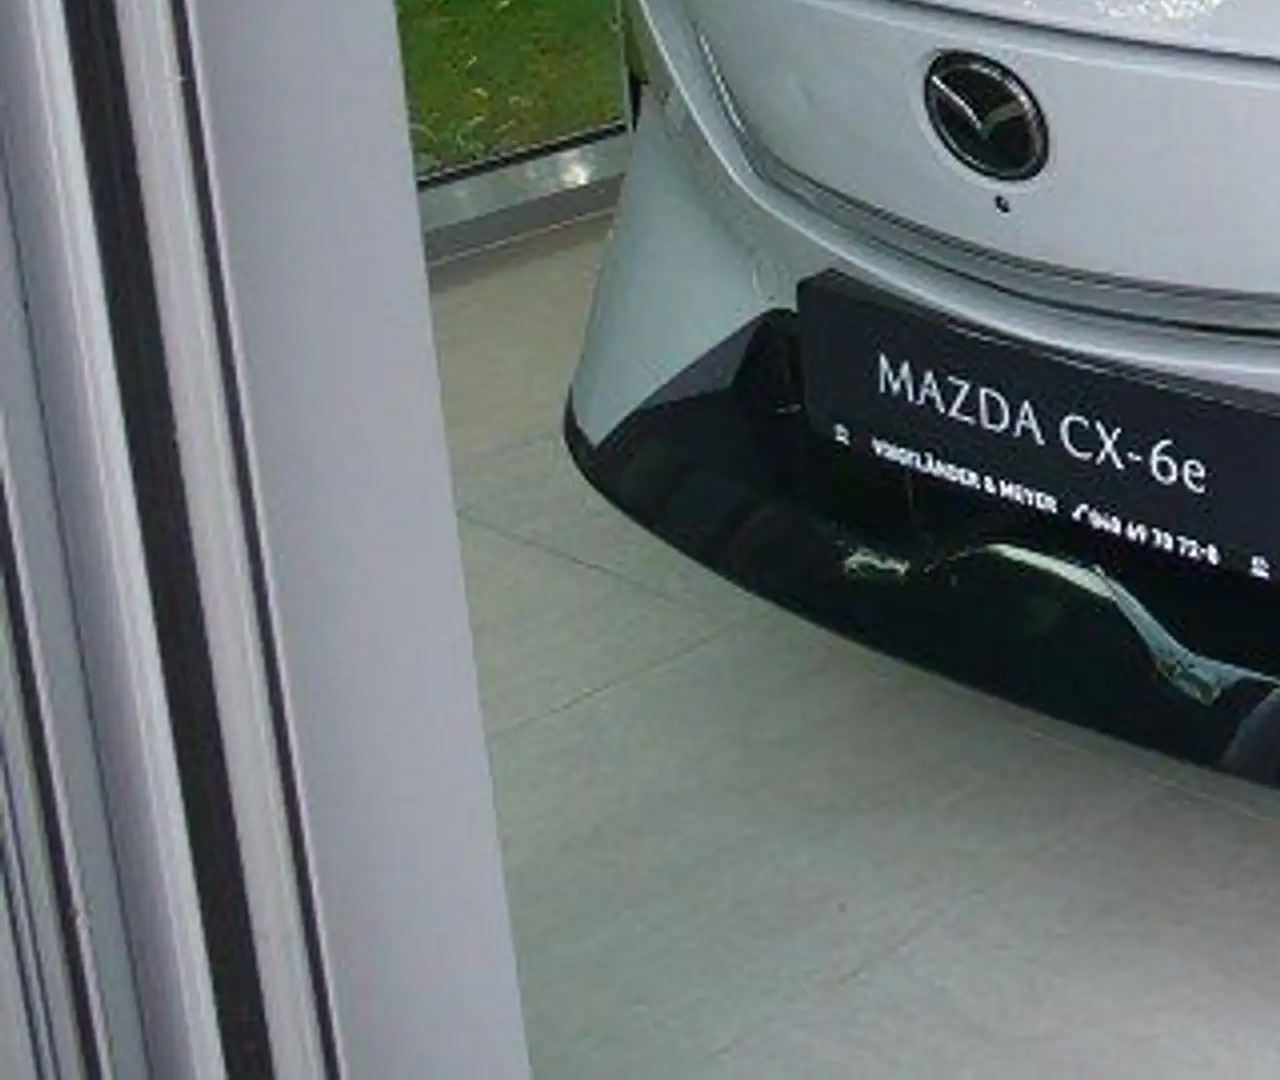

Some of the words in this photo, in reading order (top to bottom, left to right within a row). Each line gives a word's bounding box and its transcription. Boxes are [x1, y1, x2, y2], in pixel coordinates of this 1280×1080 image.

[879, 353, 1045, 446] MAZDA
[1059, 412, 1207, 494] CX-6e
[999, 478, 1059, 514] MEYER
